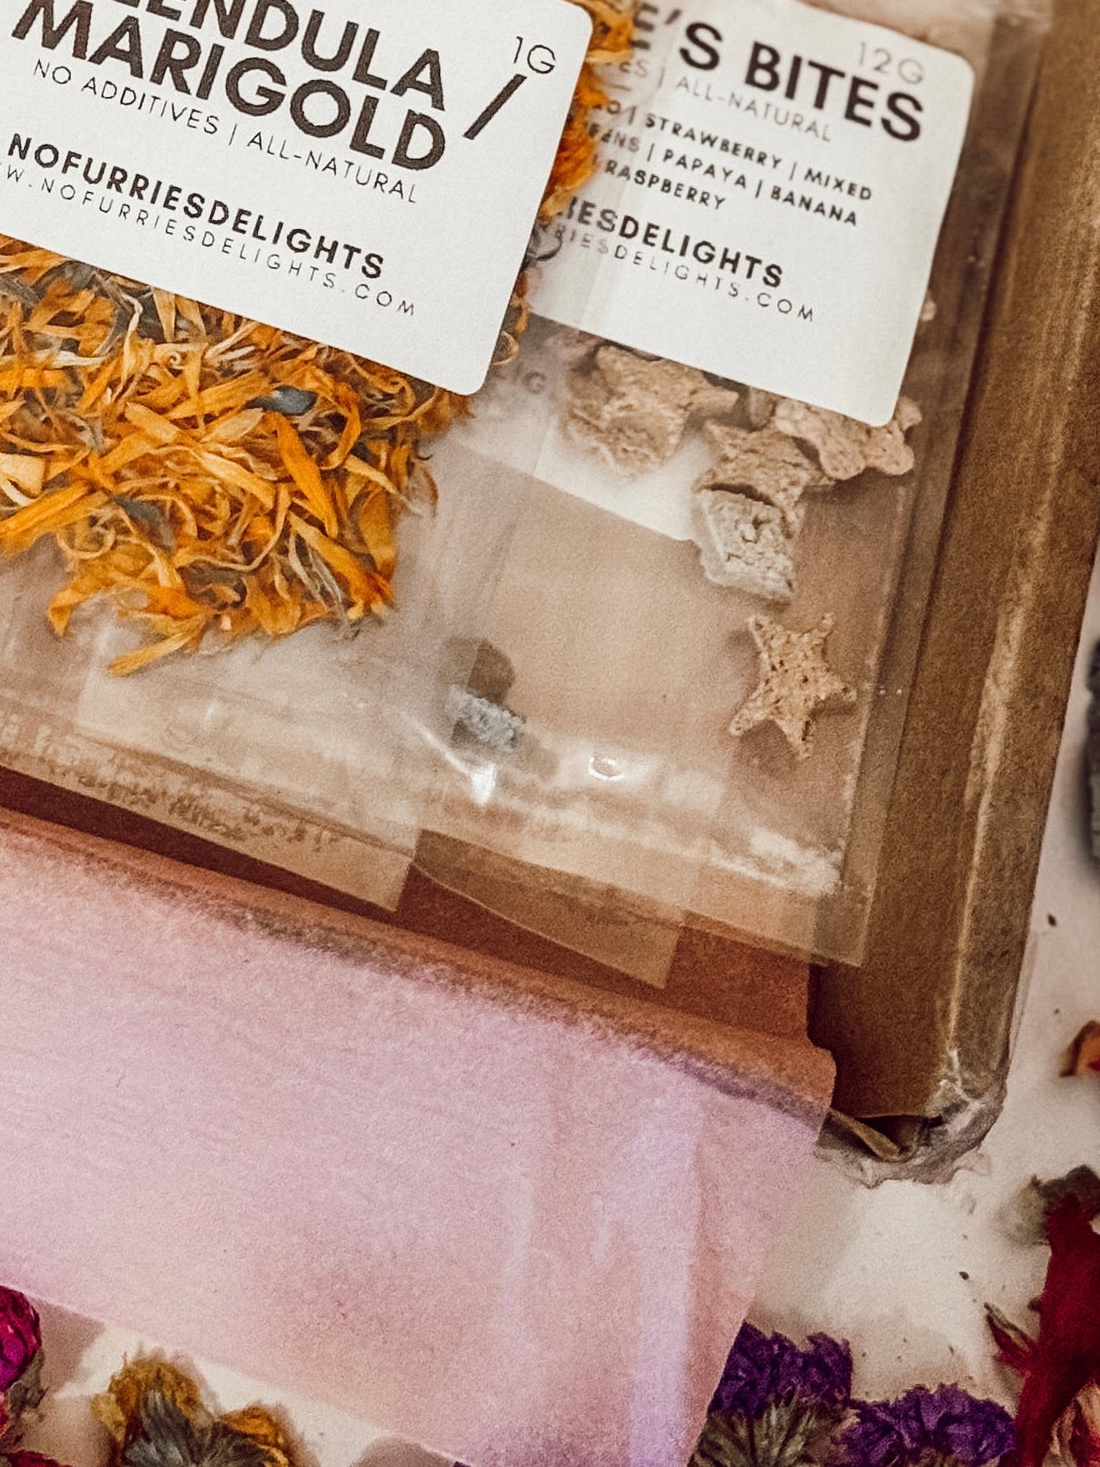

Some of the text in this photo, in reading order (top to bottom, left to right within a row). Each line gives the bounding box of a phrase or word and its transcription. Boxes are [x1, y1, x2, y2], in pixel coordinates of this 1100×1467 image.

[512, 36, 558, 76] 1G
[744, 40, 924, 142] BITES
[857, 42, 925, 85] 12G
[33, 58, 72, 84] NO
[81, 76, 220, 134] ADDITIVES
[247, 131, 417, 204] ALL-NATURAL
[676, 75, 833, 143] ALL-NATURAL
[605, 159, 728, 211] RASPBERRY
[645, 113, 783, 169] STRAWBERRY
[804, 168, 874, 201] MIXED
[663, 149, 748, 190] PAPAYA
[770, 185, 858, 227] BANANA
[7, 133, 385, 280] NOFURRIESDELIGHTS
